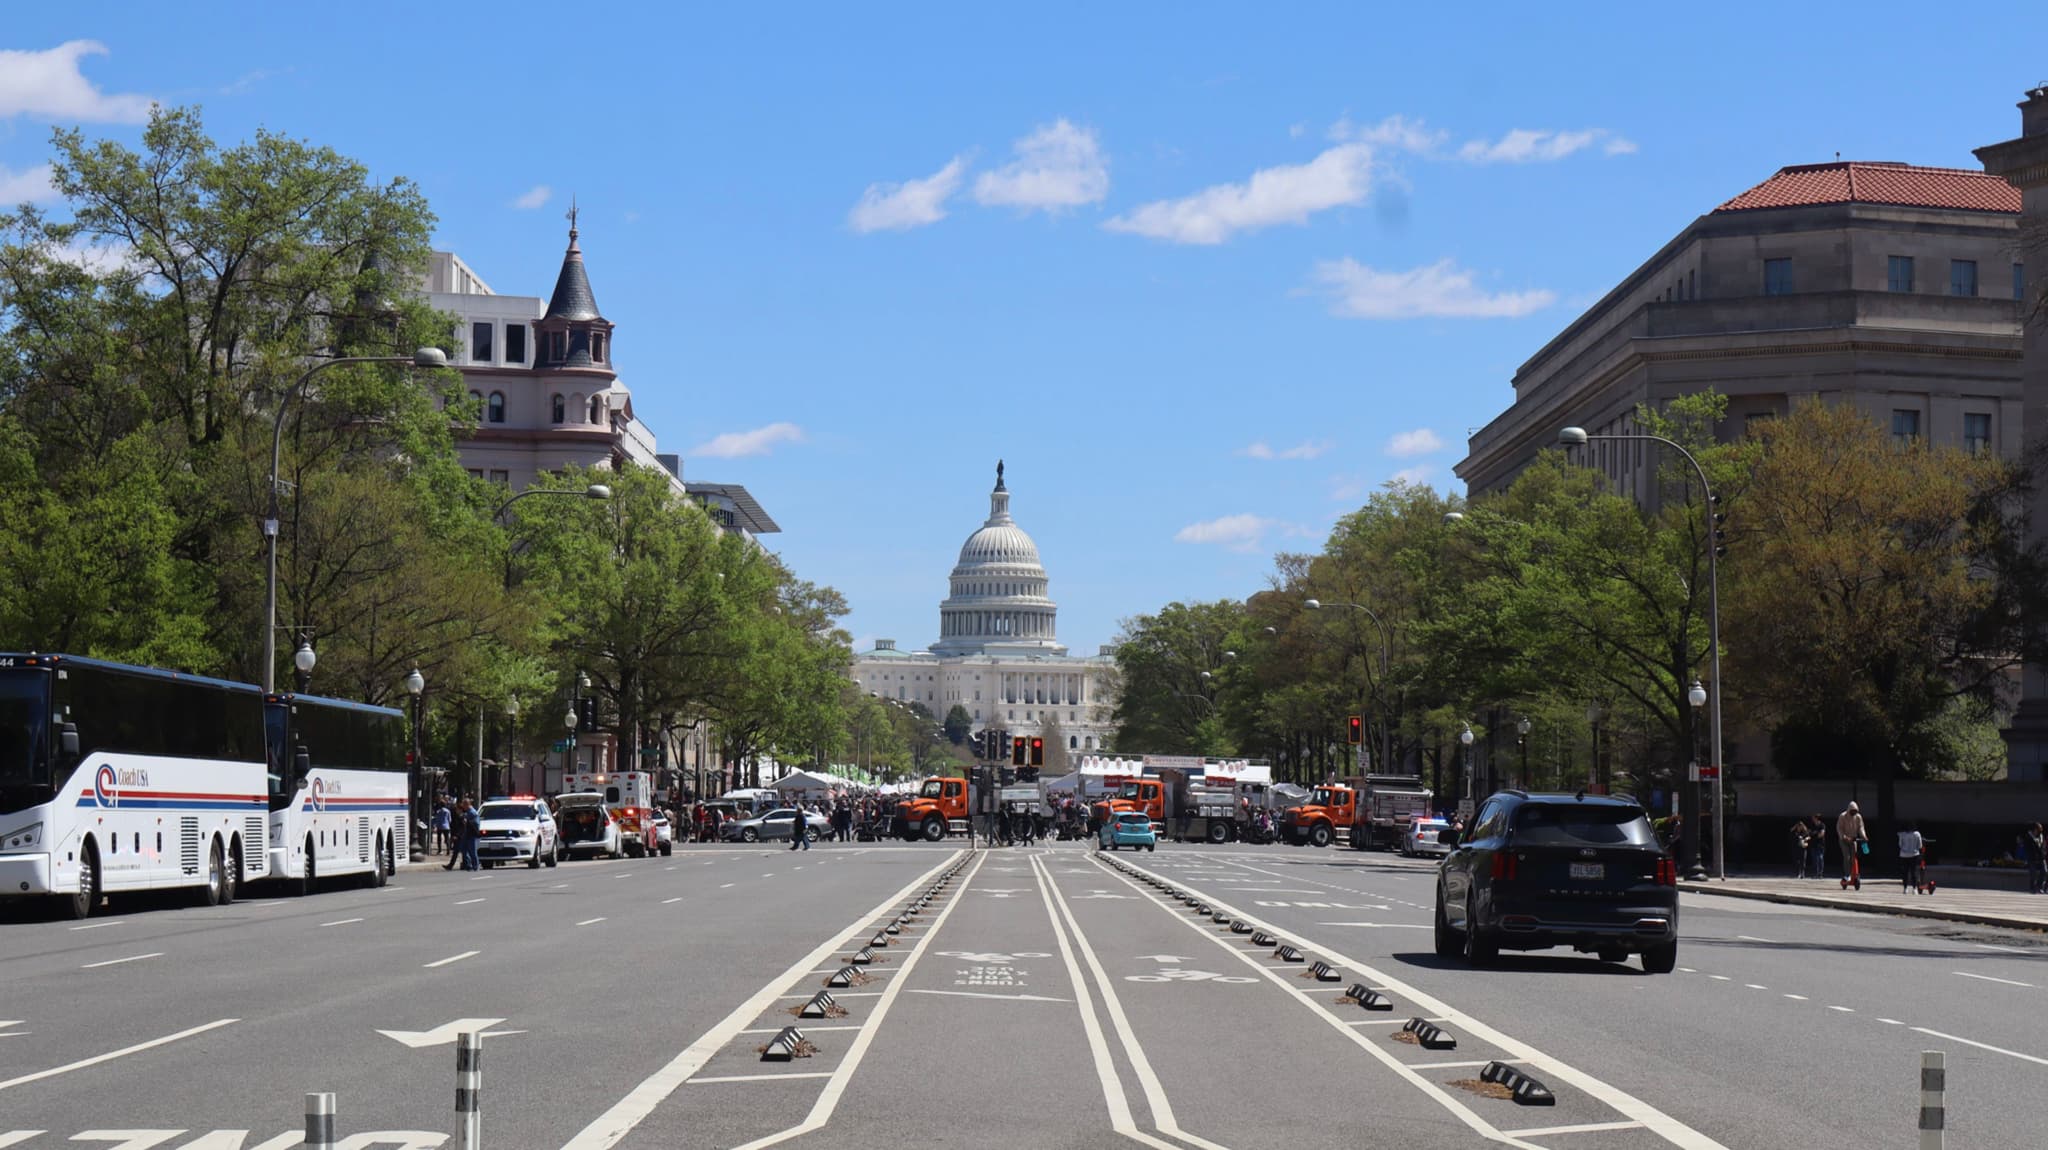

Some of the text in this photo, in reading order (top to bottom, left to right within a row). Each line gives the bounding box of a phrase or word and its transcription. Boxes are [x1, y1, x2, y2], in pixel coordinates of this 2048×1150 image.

[118, 768, 149, 787] Coach USA
[1254, 901, 1392, 911] ONLY
